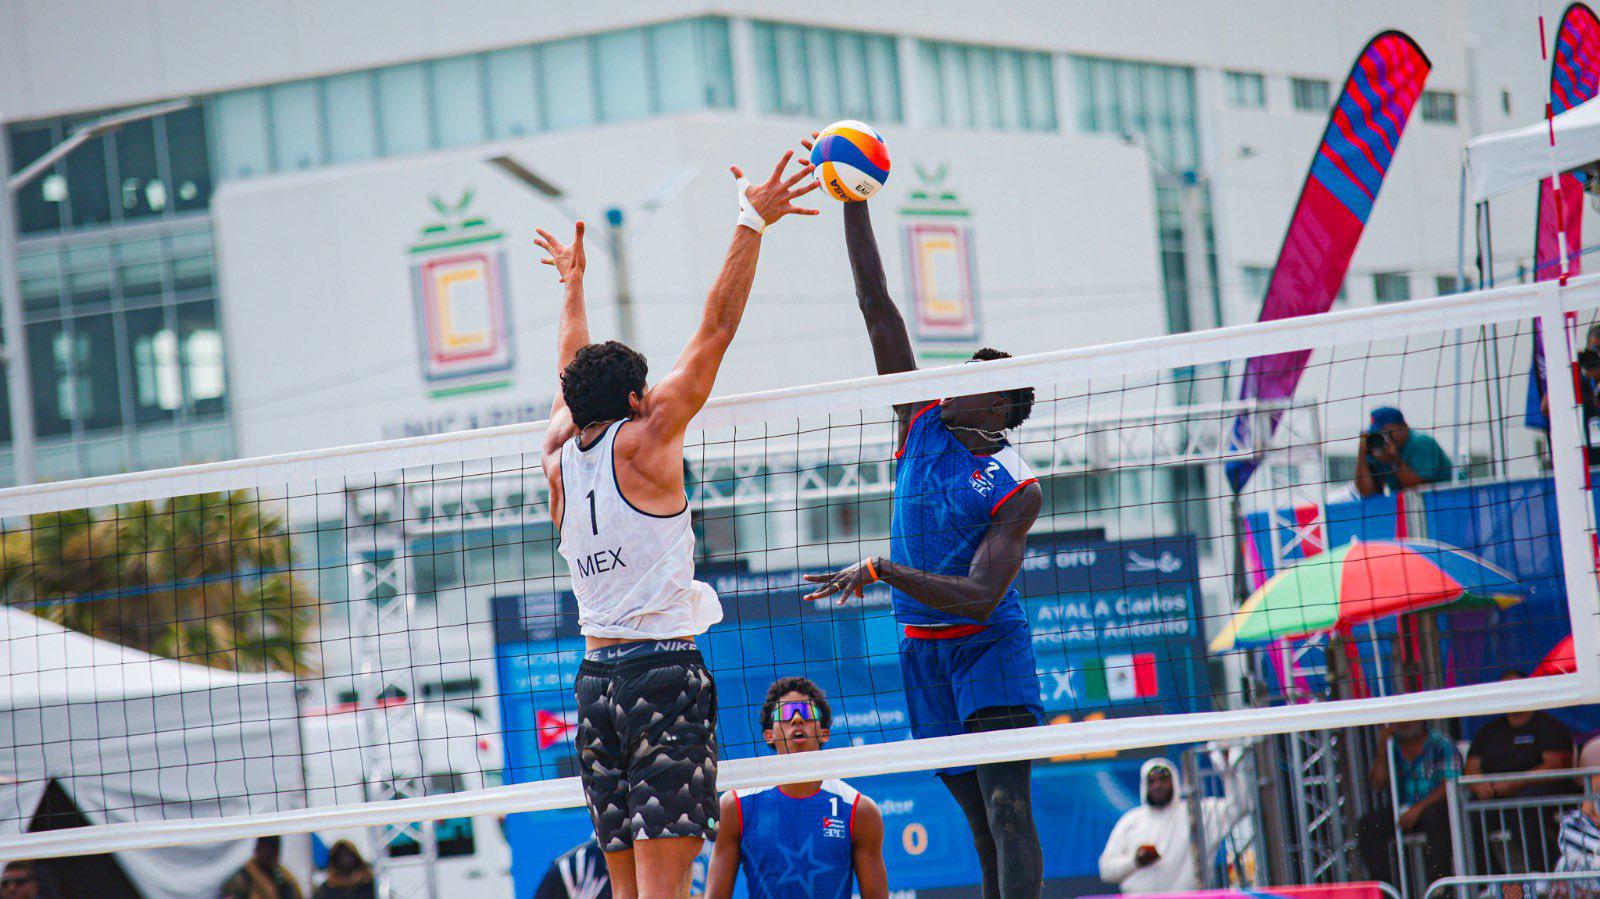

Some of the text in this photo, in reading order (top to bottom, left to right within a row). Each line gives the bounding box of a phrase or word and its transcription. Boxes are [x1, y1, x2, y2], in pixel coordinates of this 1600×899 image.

[985, 461, 1000, 479] 2
[586, 490, 598, 536] 1
[577, 547, 626, 578] MEX
[1038, 591, 1187, 621] AYALA Carlos
[829, 797, 838, 817] 1
[902, 823, 928, 856] 0
